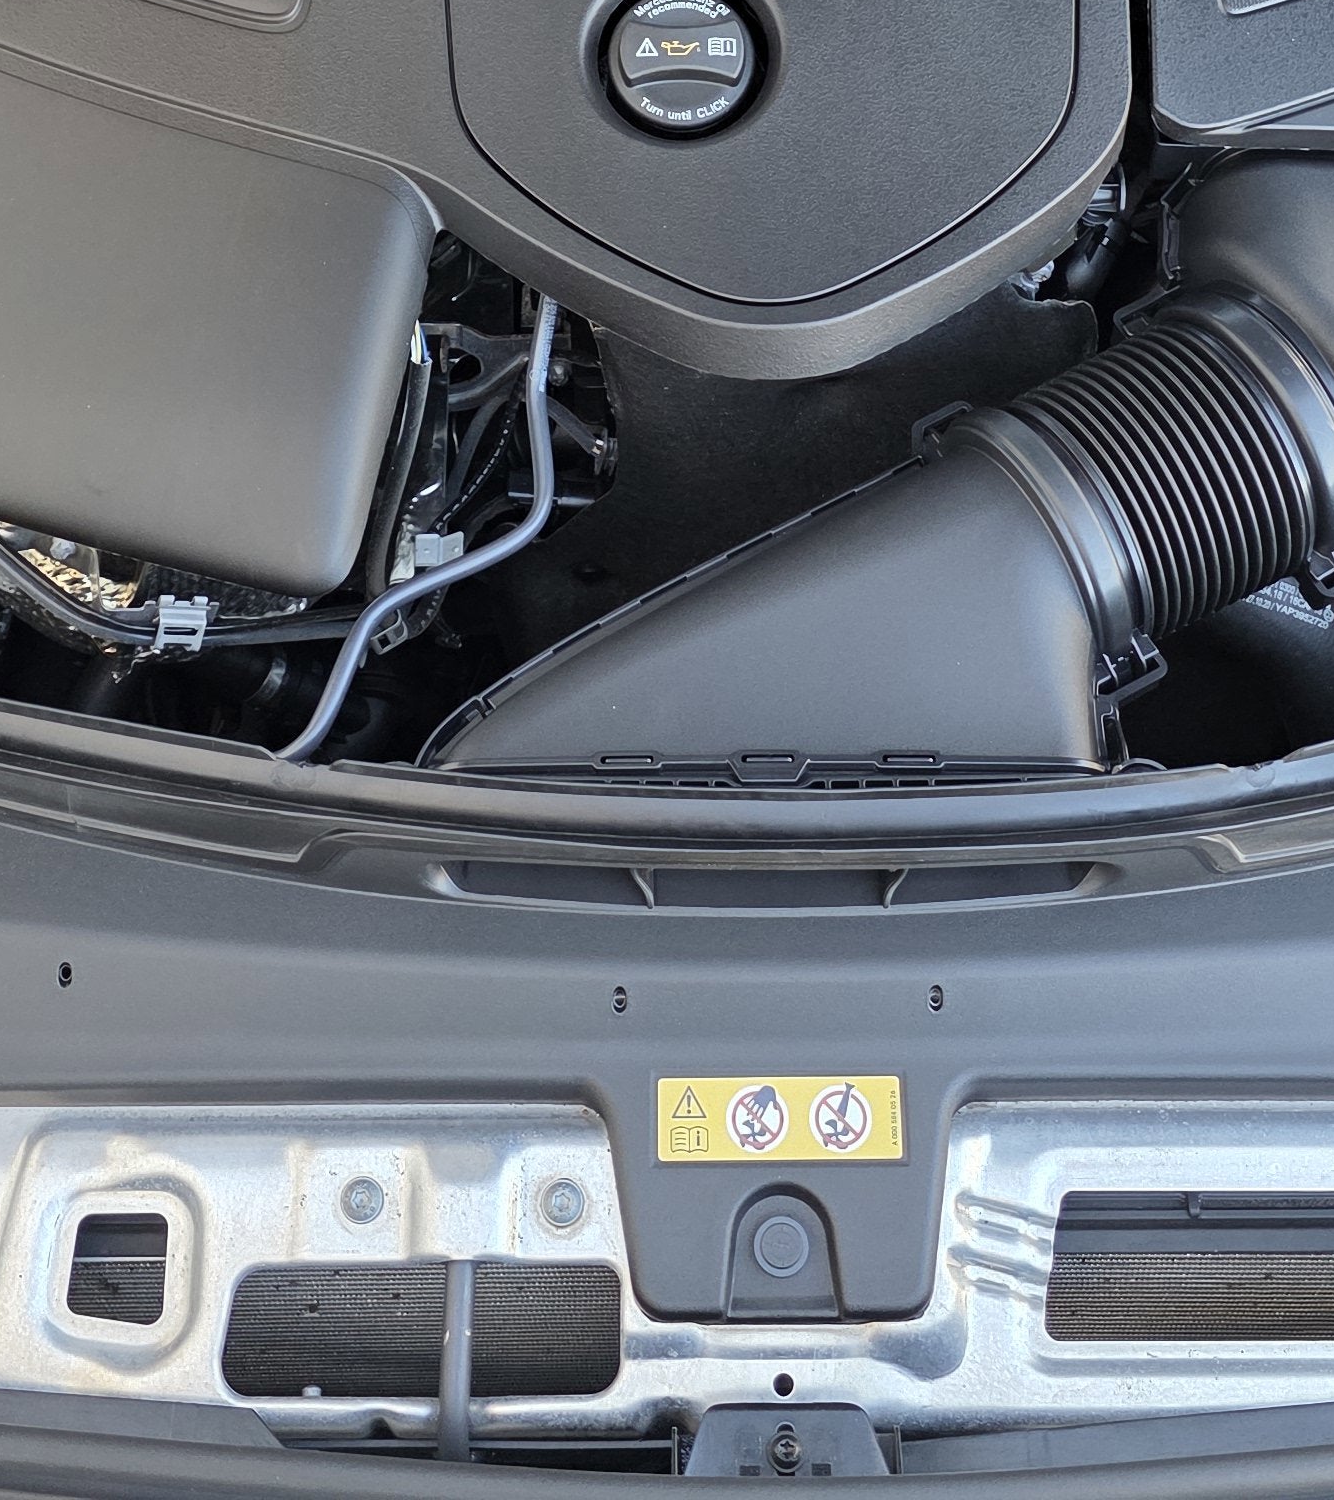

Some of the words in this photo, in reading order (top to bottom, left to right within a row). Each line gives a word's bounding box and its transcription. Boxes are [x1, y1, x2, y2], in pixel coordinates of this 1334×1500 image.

[648, 1, 719, 19] recommended
[716, 4, 730, 16] Oil
[640, 97, 664, 117] Turn
[668, 110, 692, 120] until
[697, 96, 730, 118] CLICK
